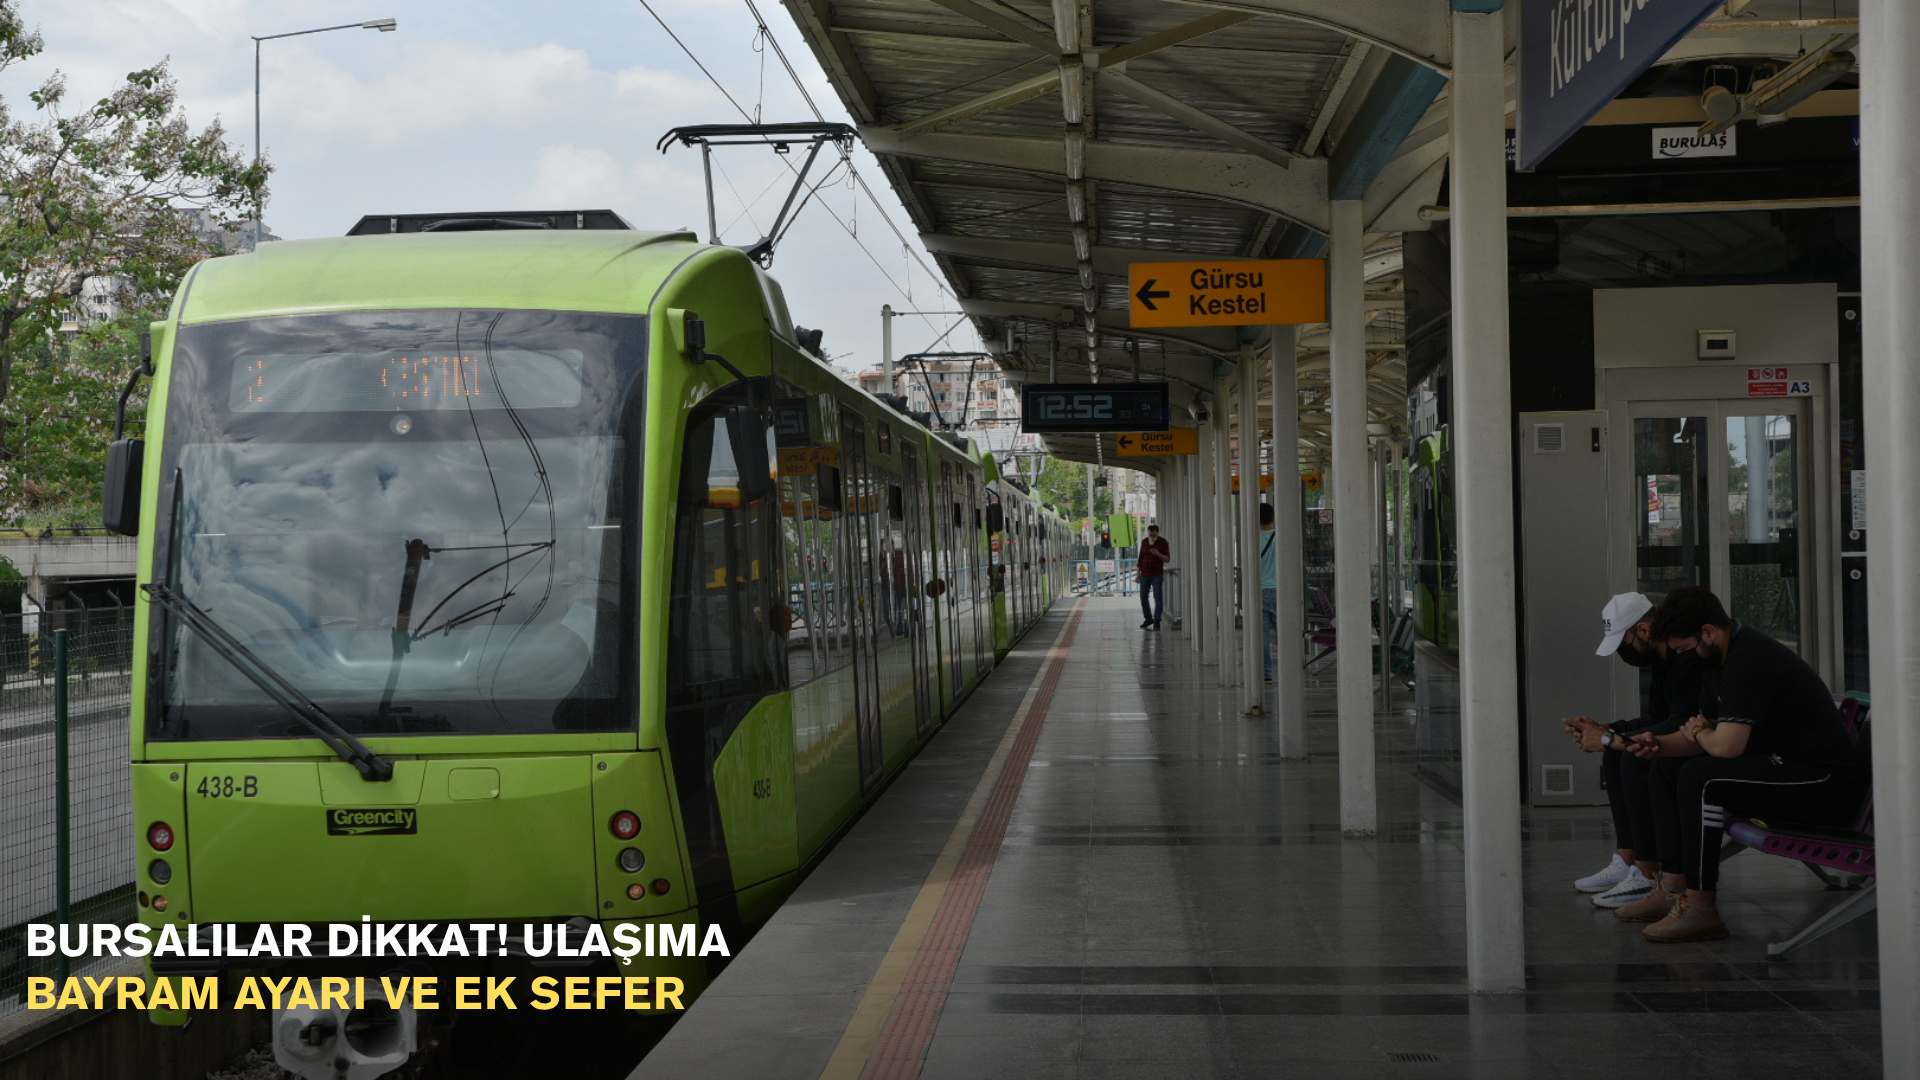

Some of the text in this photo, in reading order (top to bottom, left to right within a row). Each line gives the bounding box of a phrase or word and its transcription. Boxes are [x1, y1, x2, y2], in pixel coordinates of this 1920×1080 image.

[1660, 136, 1728, 150] BURULAŞ
[1190, 268, 1264, 291] Gürsu
[1189, 292, 1266, 316] Kestel
[1790, 381, 1811, 394] A3
[1035, 395, 1113, 420] 12:52
[1141, 442, 1174, 452] Kestel
[1142, 432, 1173, 442] Gürsu
[197, 775, 259, 798] 438-B
[333, 809, 415, 829] Greencity
